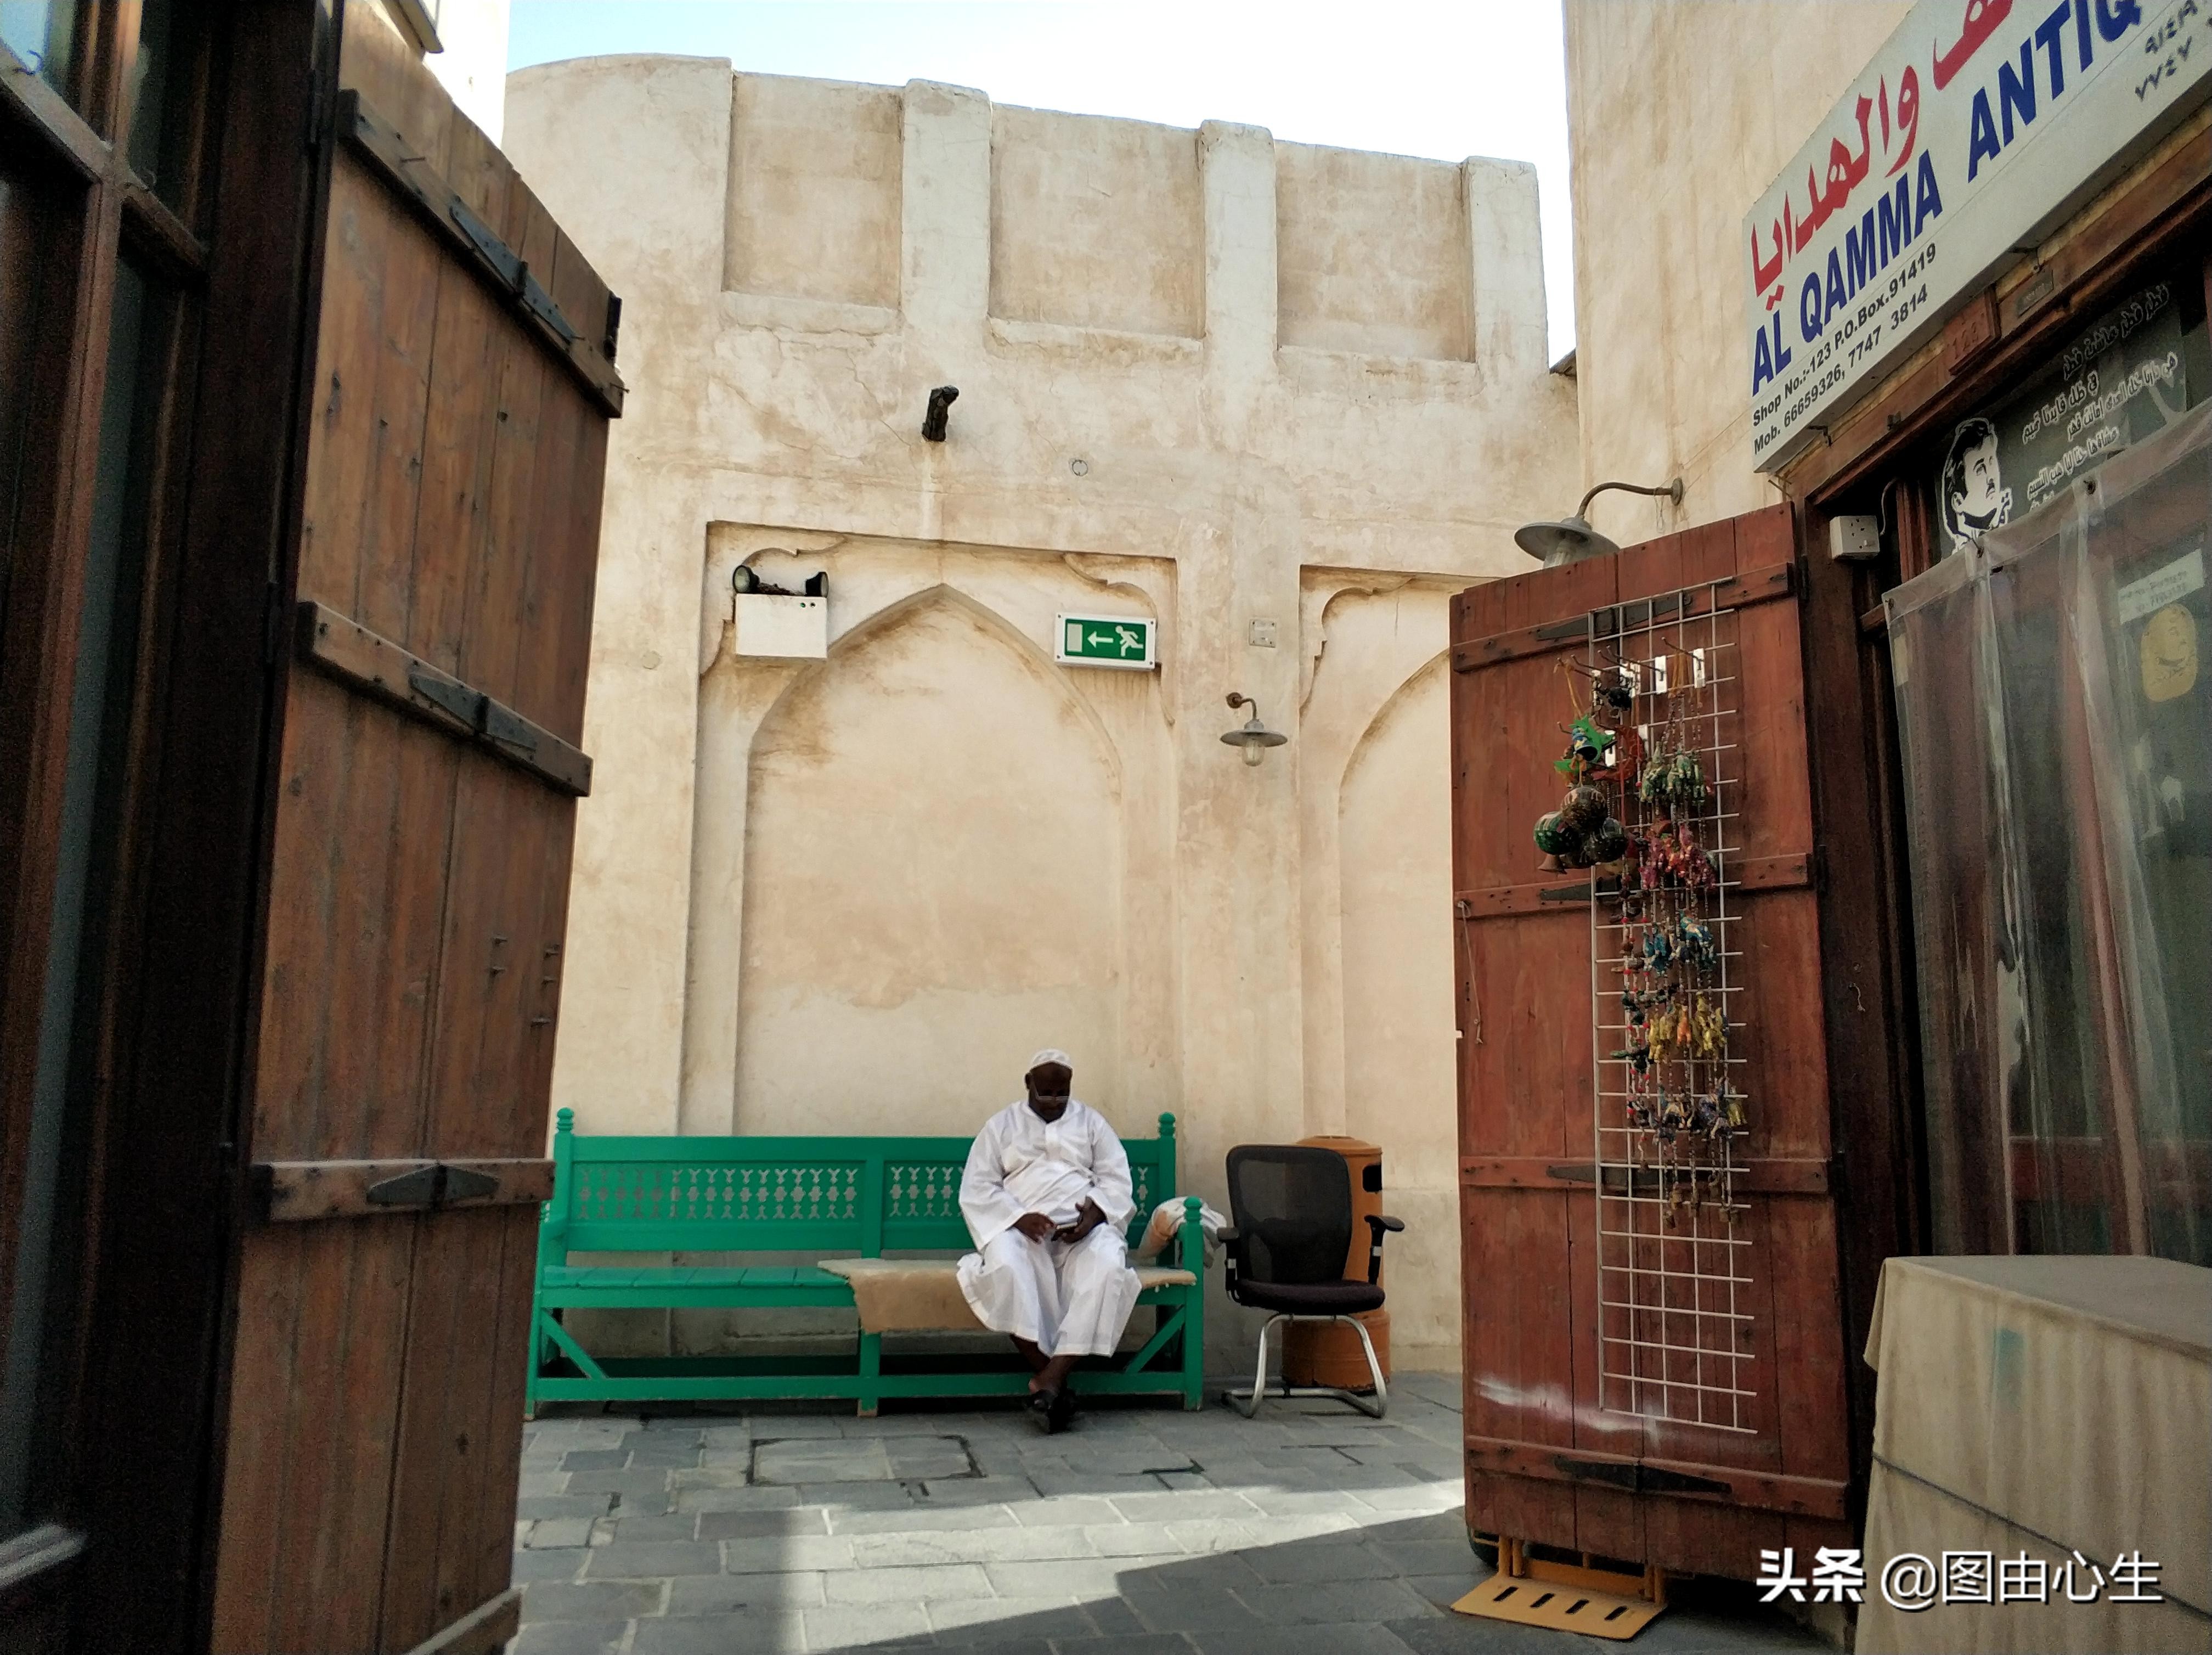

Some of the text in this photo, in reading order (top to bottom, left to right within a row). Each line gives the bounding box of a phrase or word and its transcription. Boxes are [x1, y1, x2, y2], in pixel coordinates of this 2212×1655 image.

[1752, 309, 1792, 397] AL
[1800, 149, 1943, 344] QAMMA
[1753, 394, 1781, 426] Shop
[1754, 425, 1781, 455] Mob.
[1848, 325, 1881, 369] 7747
[1891, 283, 1927, 330] 3814
